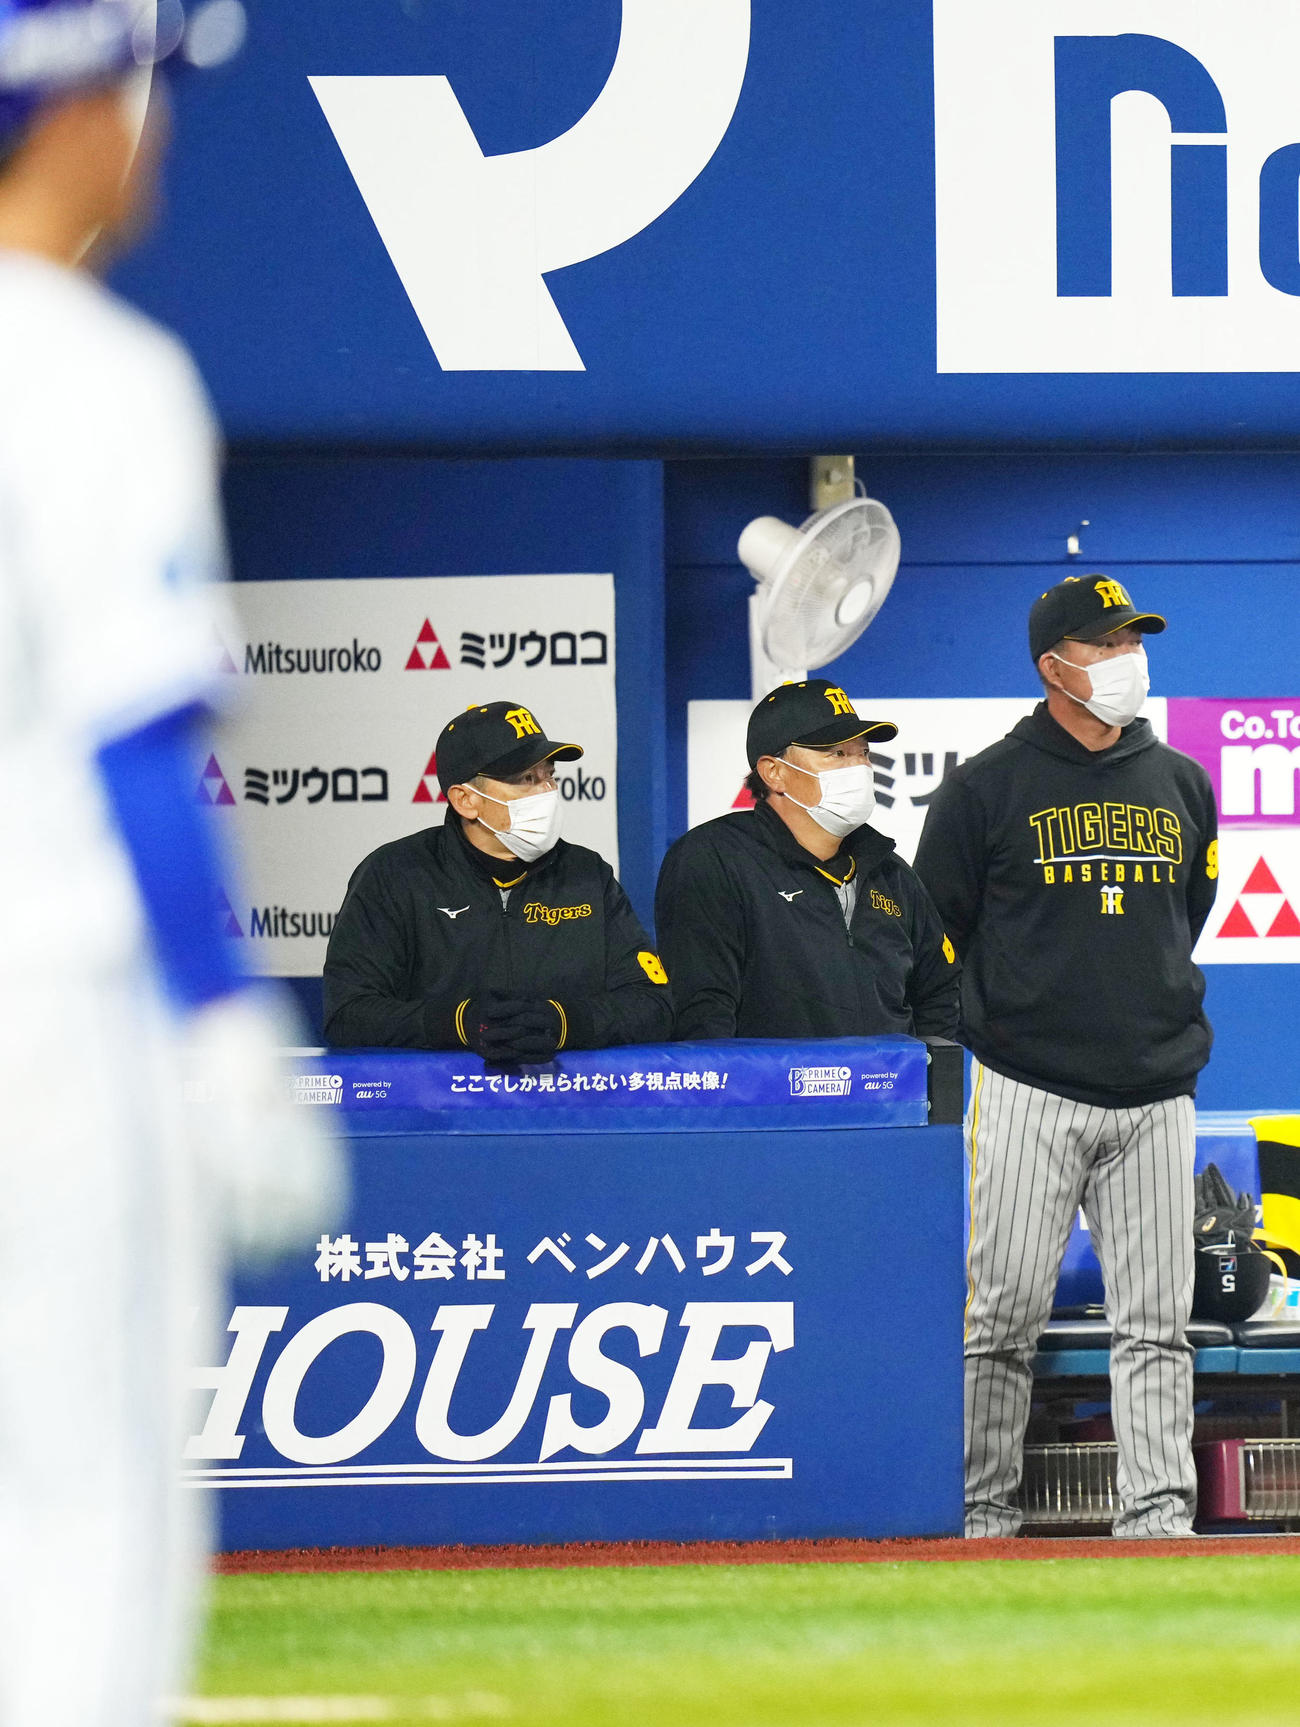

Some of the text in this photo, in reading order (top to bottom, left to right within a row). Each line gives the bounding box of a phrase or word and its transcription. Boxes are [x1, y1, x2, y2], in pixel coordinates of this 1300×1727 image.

[244, 638, 382, 674] Mitsuuroko
[460, 630, 608, 669] ミツウロコ
[244, 766, 389, 806] ミツウロコ
[1029, 802, 1183, 865] TIGERS
[1043, 863, 1176, 884] BASEBALL
[250, 905, 340, 938] Mitsuu
[523, 902, 592, 925] Tigers
[353, 1081, 391, 1089] powered by
[808, 1069, 836, 1079] PRIME
[861, 1071, 898, 1080] powered by
[356, 1090, 387, 1099] au 5G
[807, 1083, 842, 1093] CAMERA
[864, 1081, 894, 1090] au 5G
[314, 1228, 794, 1282] 株式会社 ベンハウス
